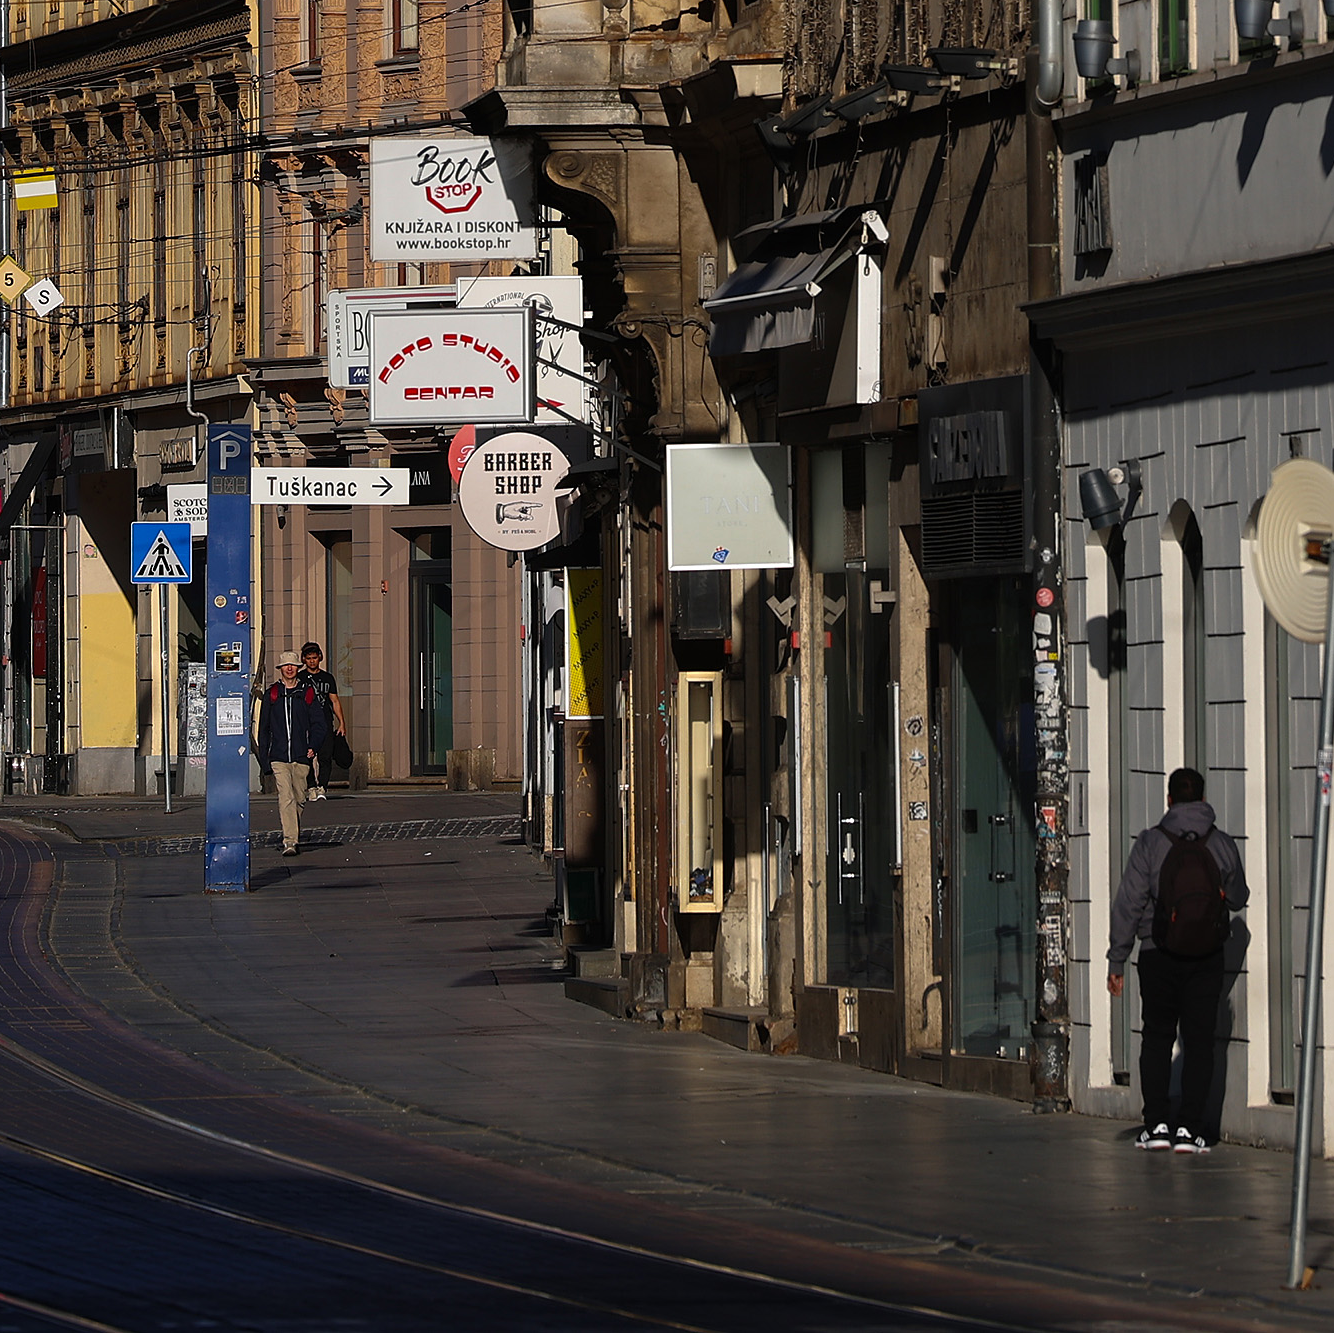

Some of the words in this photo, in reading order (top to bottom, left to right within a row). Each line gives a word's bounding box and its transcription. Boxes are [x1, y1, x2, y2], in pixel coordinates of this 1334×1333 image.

[435, 183, 472, 199] STOP
[385, 219, 451, 234] KNJIŽARA
[457, 222, 460, 233] I
[466, 220, 522, 233] DISKONT
[396, 237, 511, 252] www.bookstop.hr
[4, 273, 15, 287] 5
[38, 290, 50, 305] S
[485, 292, 525, 308] TERNATIONAL
[334, 304, 342, 358] SPORTSKA
[378, 336, 433, 384] FOTO
[442, 333, 520, 383] STUDIO
[404, 386, 494, 400] CENTAR
[220, 440, 241, 470] P
[484, 452, 553, 471] BARBER
[267, 476, 357, 498] Tuškanac
[495, 476, 542, 495] SHOP
[173, 498, 207, 507] SCOTC
[185, 507, 208, 516] SOD
